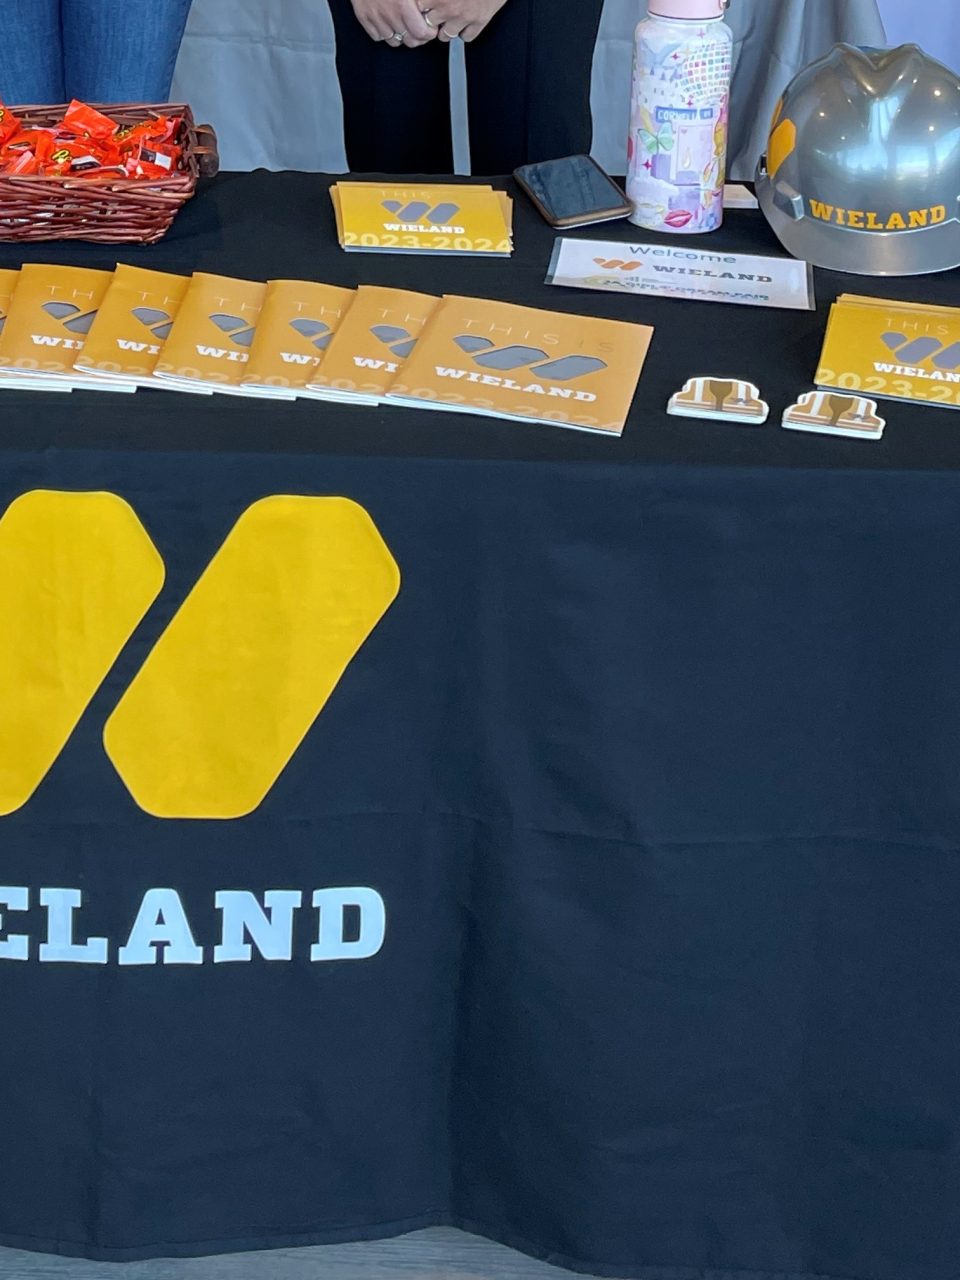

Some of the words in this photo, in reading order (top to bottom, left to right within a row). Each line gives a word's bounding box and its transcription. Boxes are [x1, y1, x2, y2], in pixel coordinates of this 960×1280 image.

[381, 190, 433, 200] THIS
[809, 198, 946, 230] WIELAND
[383, 223, 465, 235] WIELAND
[630, 245, 737, 264] Welcome
[652, 264, 773, 283] WIELAND
[464, 318, 560, 345] THIS
[886, 318, 949, 336] THIS
[873, 362, 960, 383] WIELAN
[434, 366, 598, 403] WIELAND
